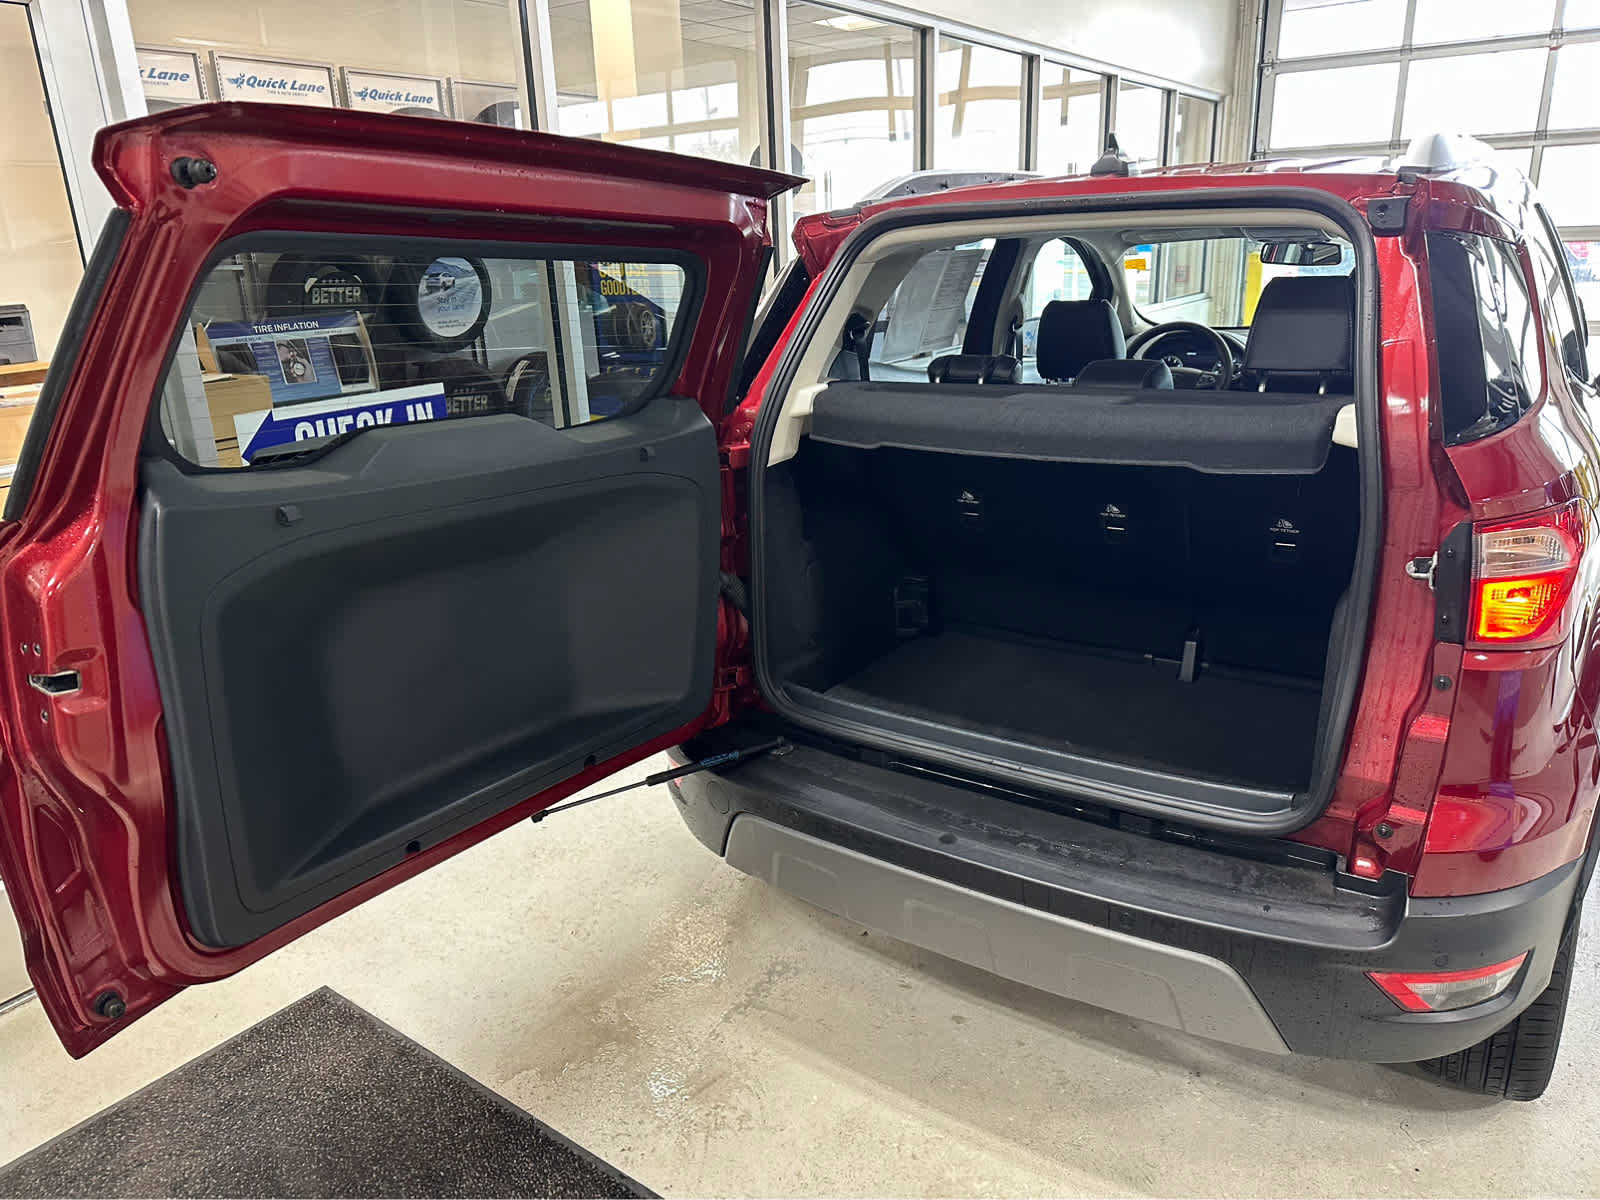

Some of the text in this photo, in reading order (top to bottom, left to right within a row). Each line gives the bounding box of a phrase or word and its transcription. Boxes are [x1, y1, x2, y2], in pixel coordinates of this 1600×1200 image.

[147, 67, 190, 82] Lane
[246, 75, 325, 94] Quick Lane
[368, 88, 404, 103] Quick
[404, 94, 434, 107] Lane
[312, 286, 361, 304] BETTER
[253, 320, 320, 334] TIRE INFLATION
[446, 395, 488, 413] BETTER
